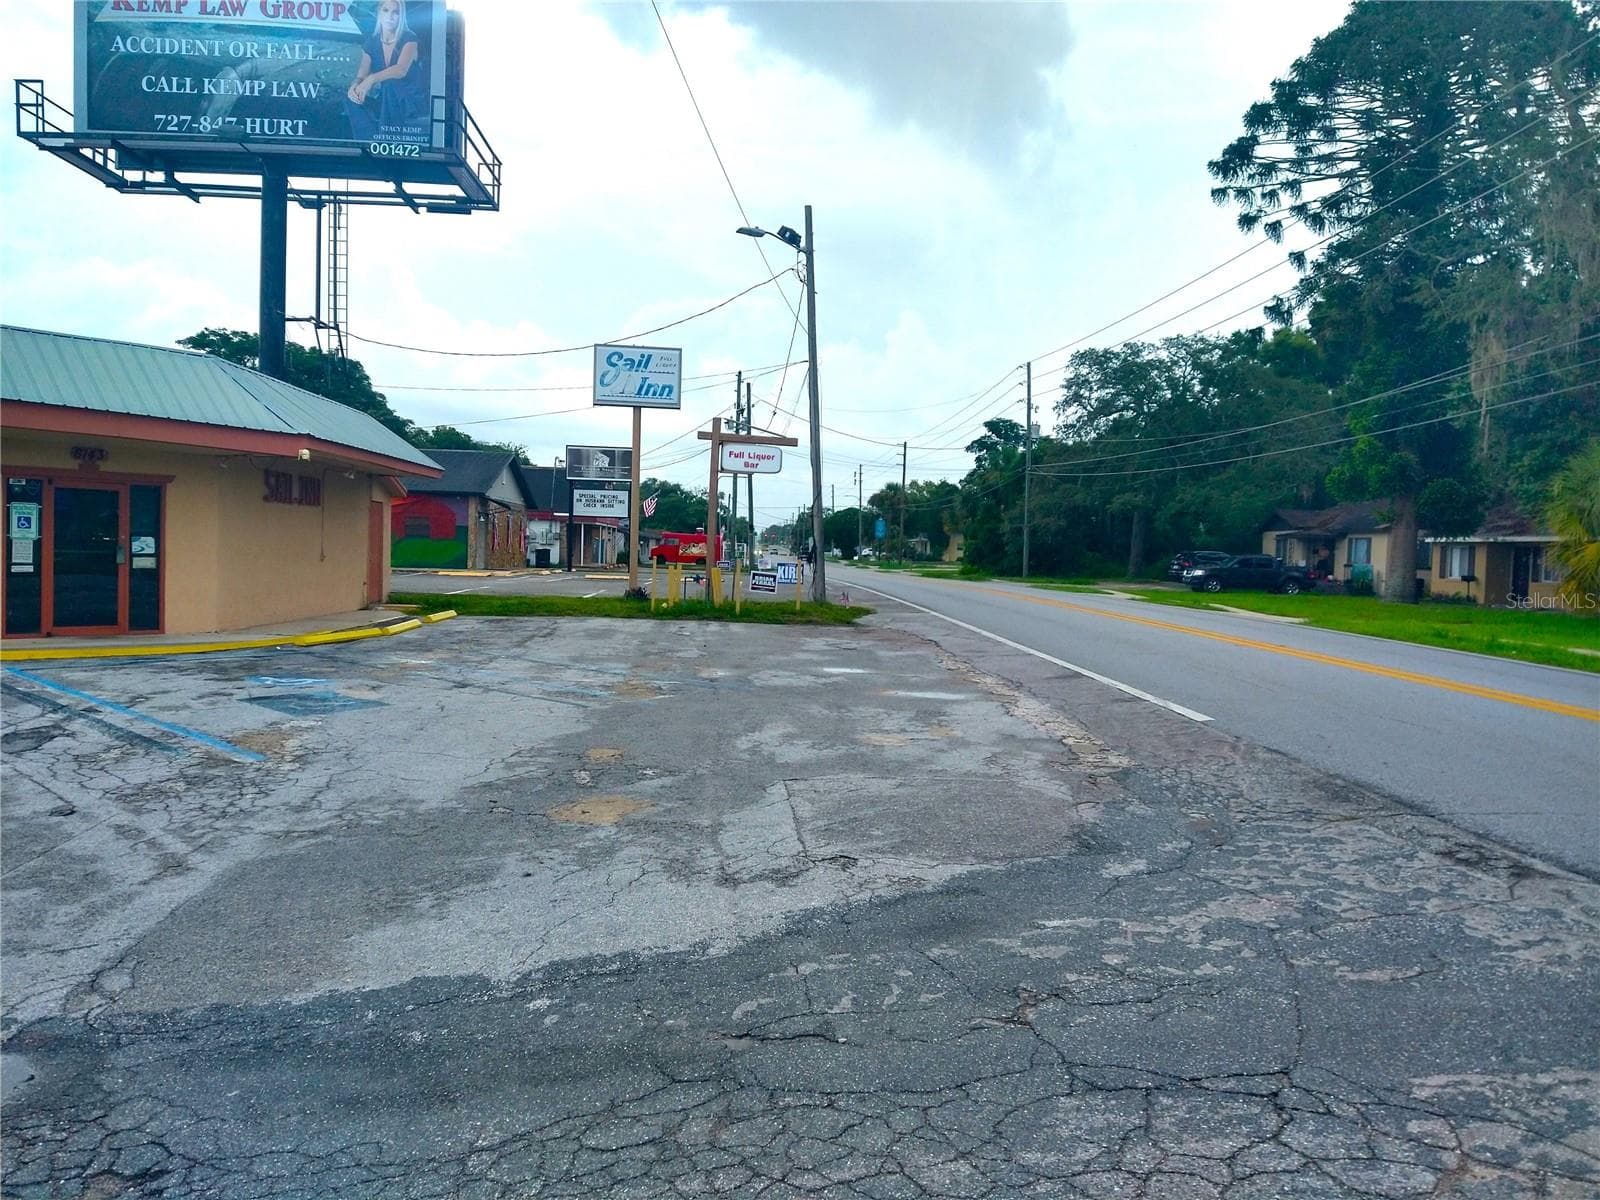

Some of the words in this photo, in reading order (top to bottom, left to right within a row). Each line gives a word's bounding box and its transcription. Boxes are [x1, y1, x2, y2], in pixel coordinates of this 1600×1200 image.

[198, 0, 248, 16] LAW
[259, 0, 347, 21] GROUP
[109, 35, 224, 56] ACCIDENT
[229, 41, 260, 58] OR
[266, 43, 350, 62] FALL.....
[141, 75, 198, 95] CALL
[202, 79, 266, 97] KEMP
[272, 82, 320, 99] LAW
[370, 143, 420, 157] 001472
[599, 351, 653, 388] Sail
[634, 376, 674, 397] Inn
[728, 450, 745, 459] Full
[748, 452, 775, 462] Liquor
[743, 461, 759, 469] Bar
